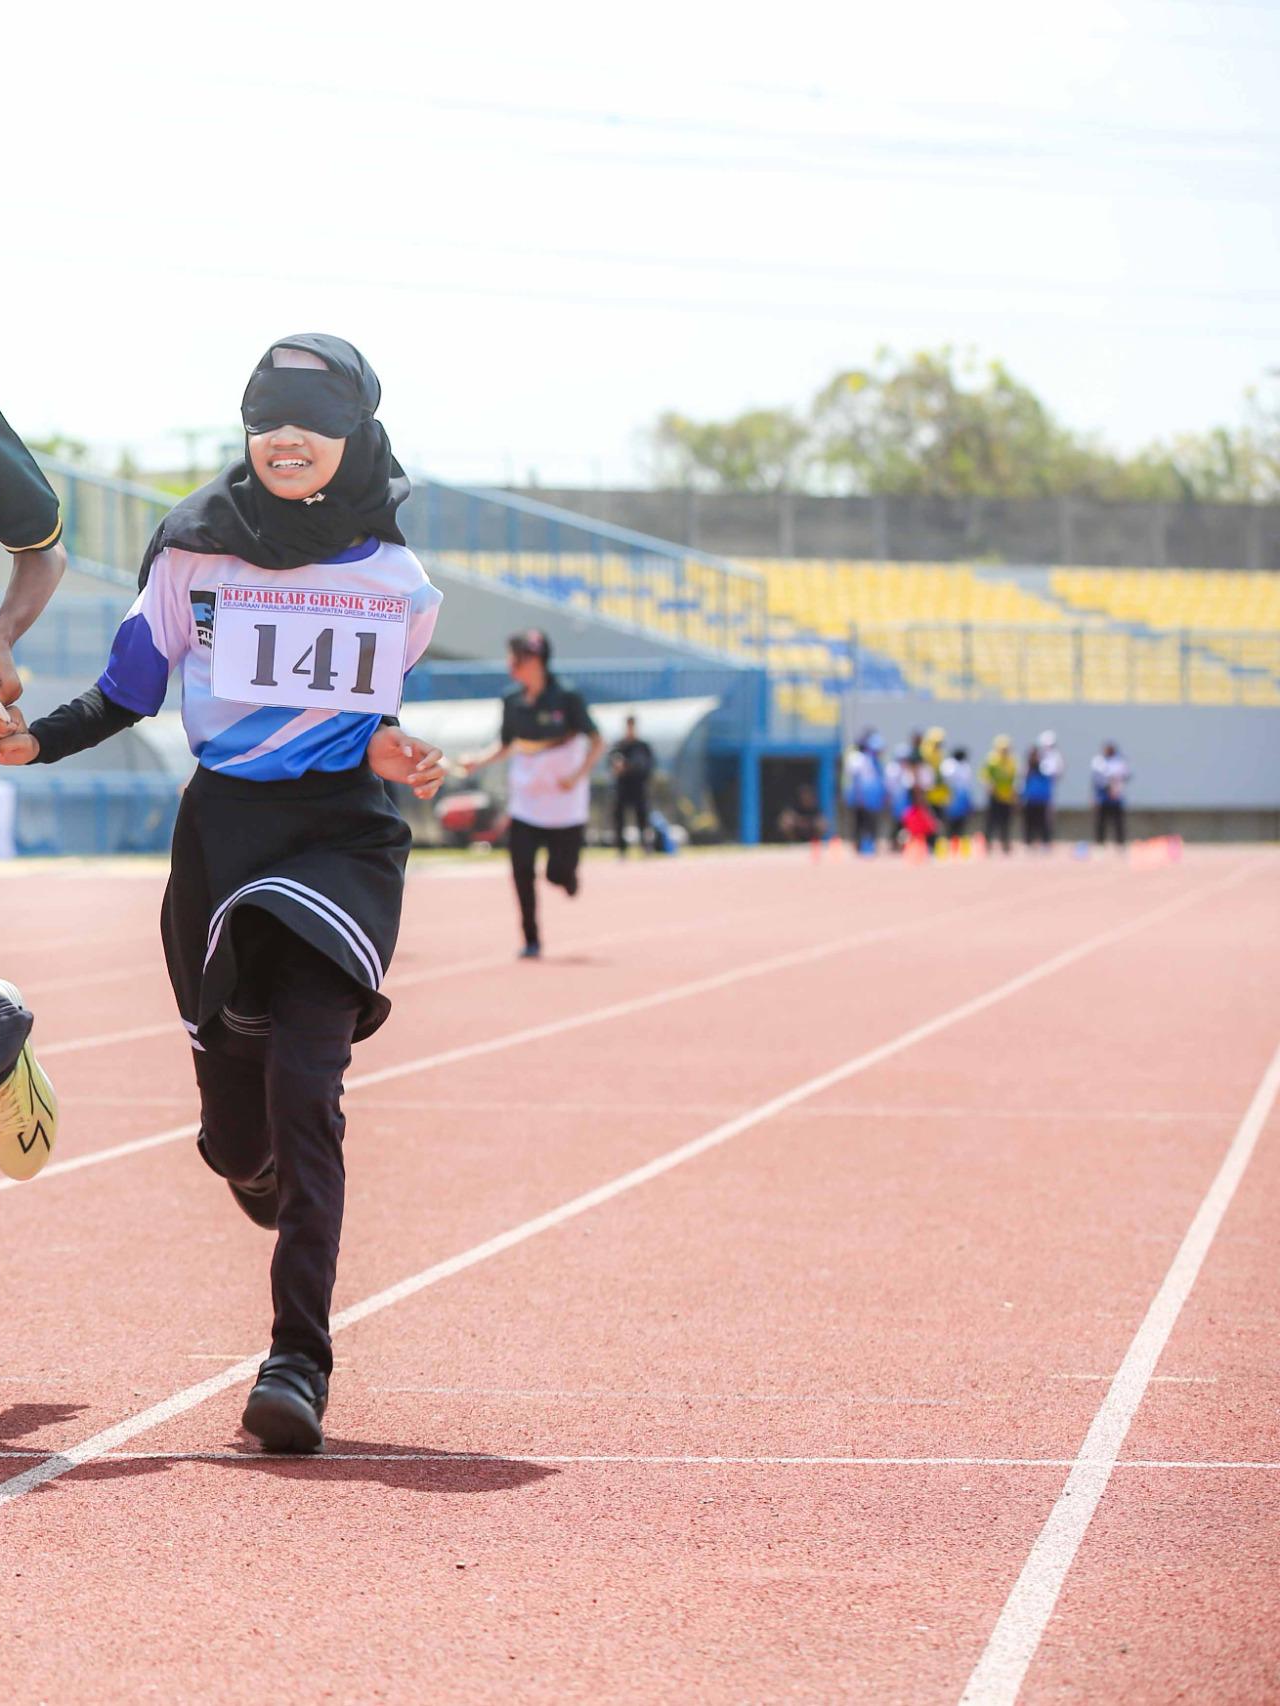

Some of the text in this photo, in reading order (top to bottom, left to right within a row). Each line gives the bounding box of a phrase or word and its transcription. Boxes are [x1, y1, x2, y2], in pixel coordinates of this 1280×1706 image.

[223, 589, 403, 614] KEPARKAB GRESIK 2025
[307, 606, 342, 614] KABUPATEN
[367, 611, 387, 619] TAHUN
[250, 624, 377, 695] 141
